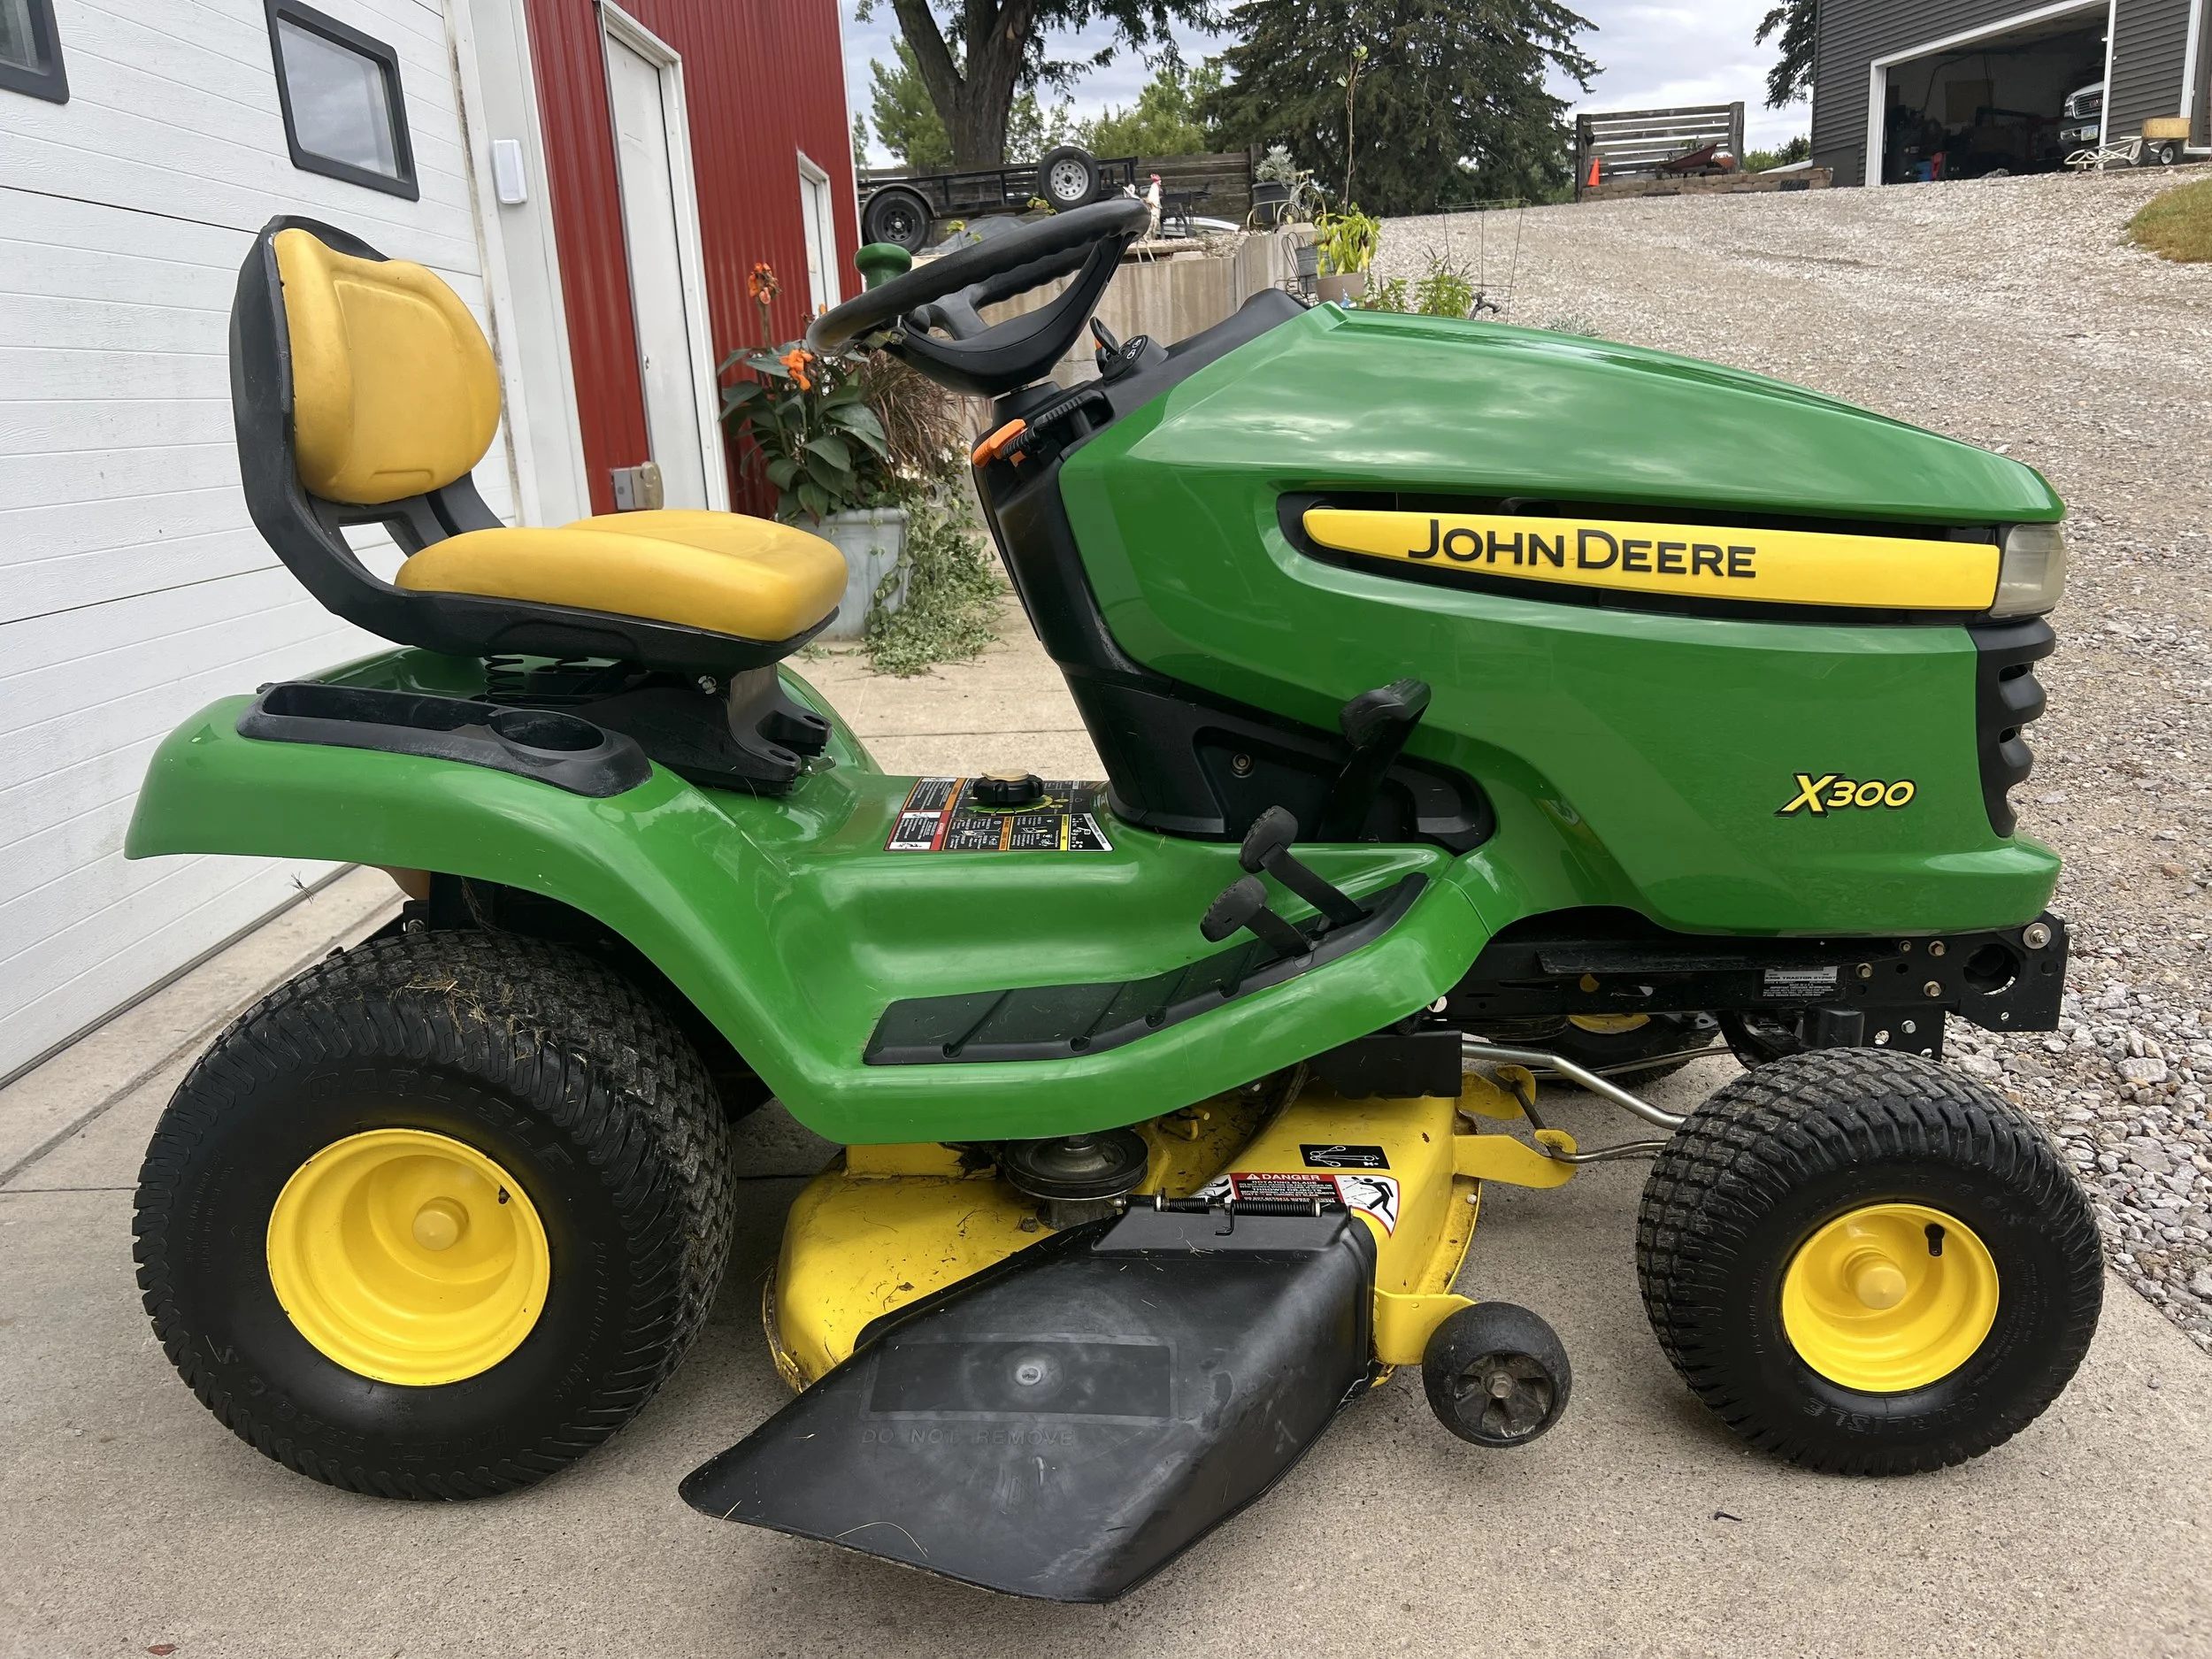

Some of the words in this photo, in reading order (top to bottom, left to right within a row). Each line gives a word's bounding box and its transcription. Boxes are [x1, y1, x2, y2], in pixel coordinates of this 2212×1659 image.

[1408, 519, 1565, 567] JOHN
[1577, 529, 1757, 578] DEERE
[1774, 772, 1917, 818] X300
[862, 1429, 895, 1445] DO
[910, 1428, 958, 1445] NOT
[976, 1429, 1075, 1447] REMOVE
